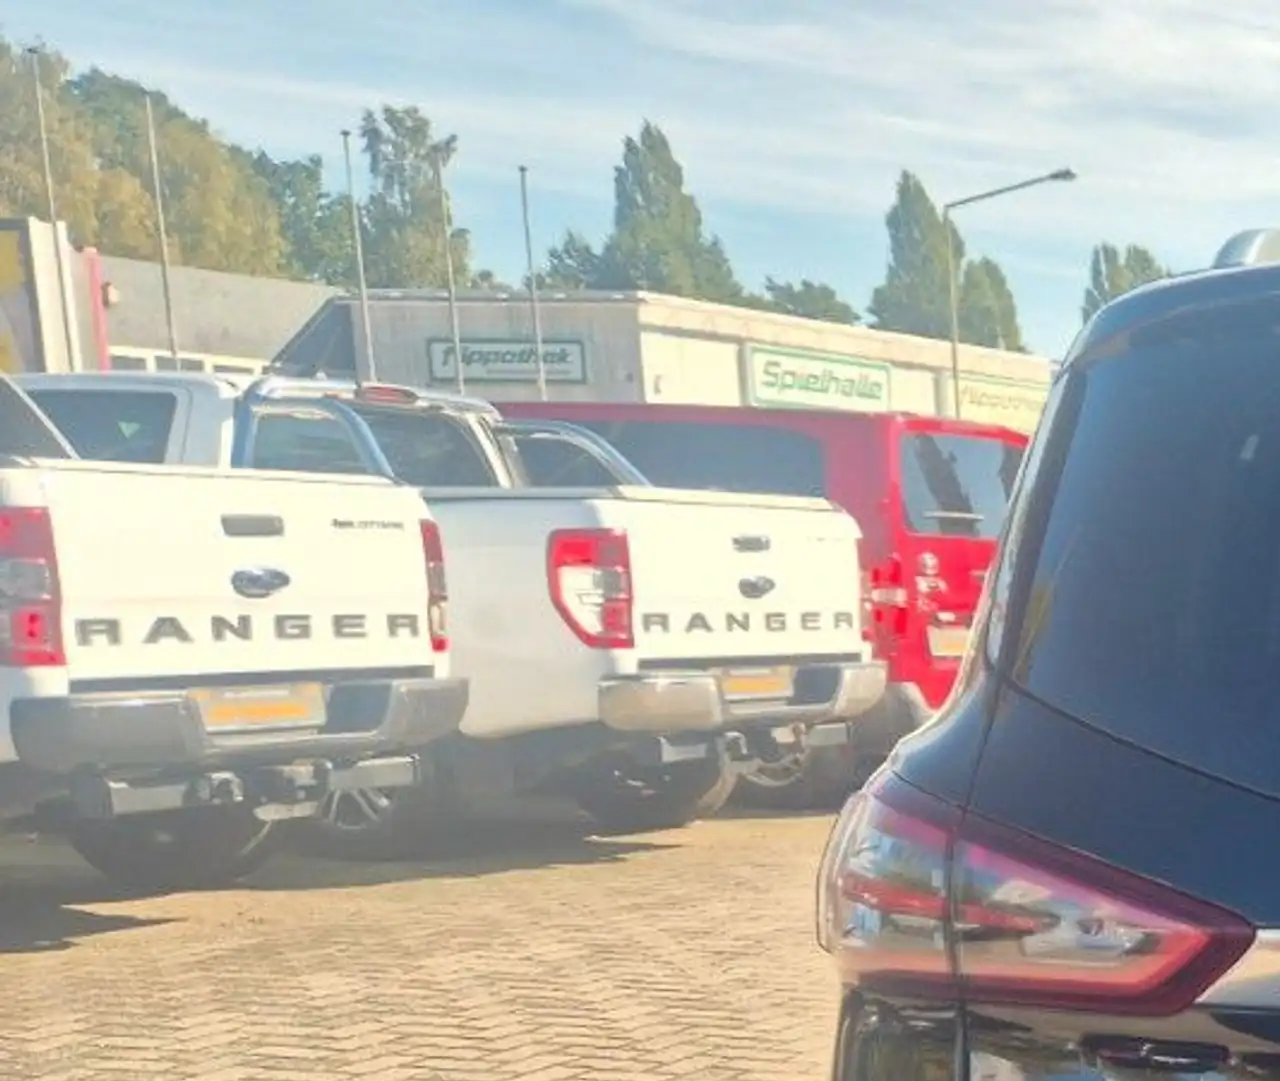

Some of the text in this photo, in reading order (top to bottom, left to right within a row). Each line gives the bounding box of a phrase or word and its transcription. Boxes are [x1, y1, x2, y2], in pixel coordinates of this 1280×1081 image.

[761, 359, 883, 400] Spielhalle
[75, 613, 420, 646] RANGER
[641, 611, 854, 633] RANGER
